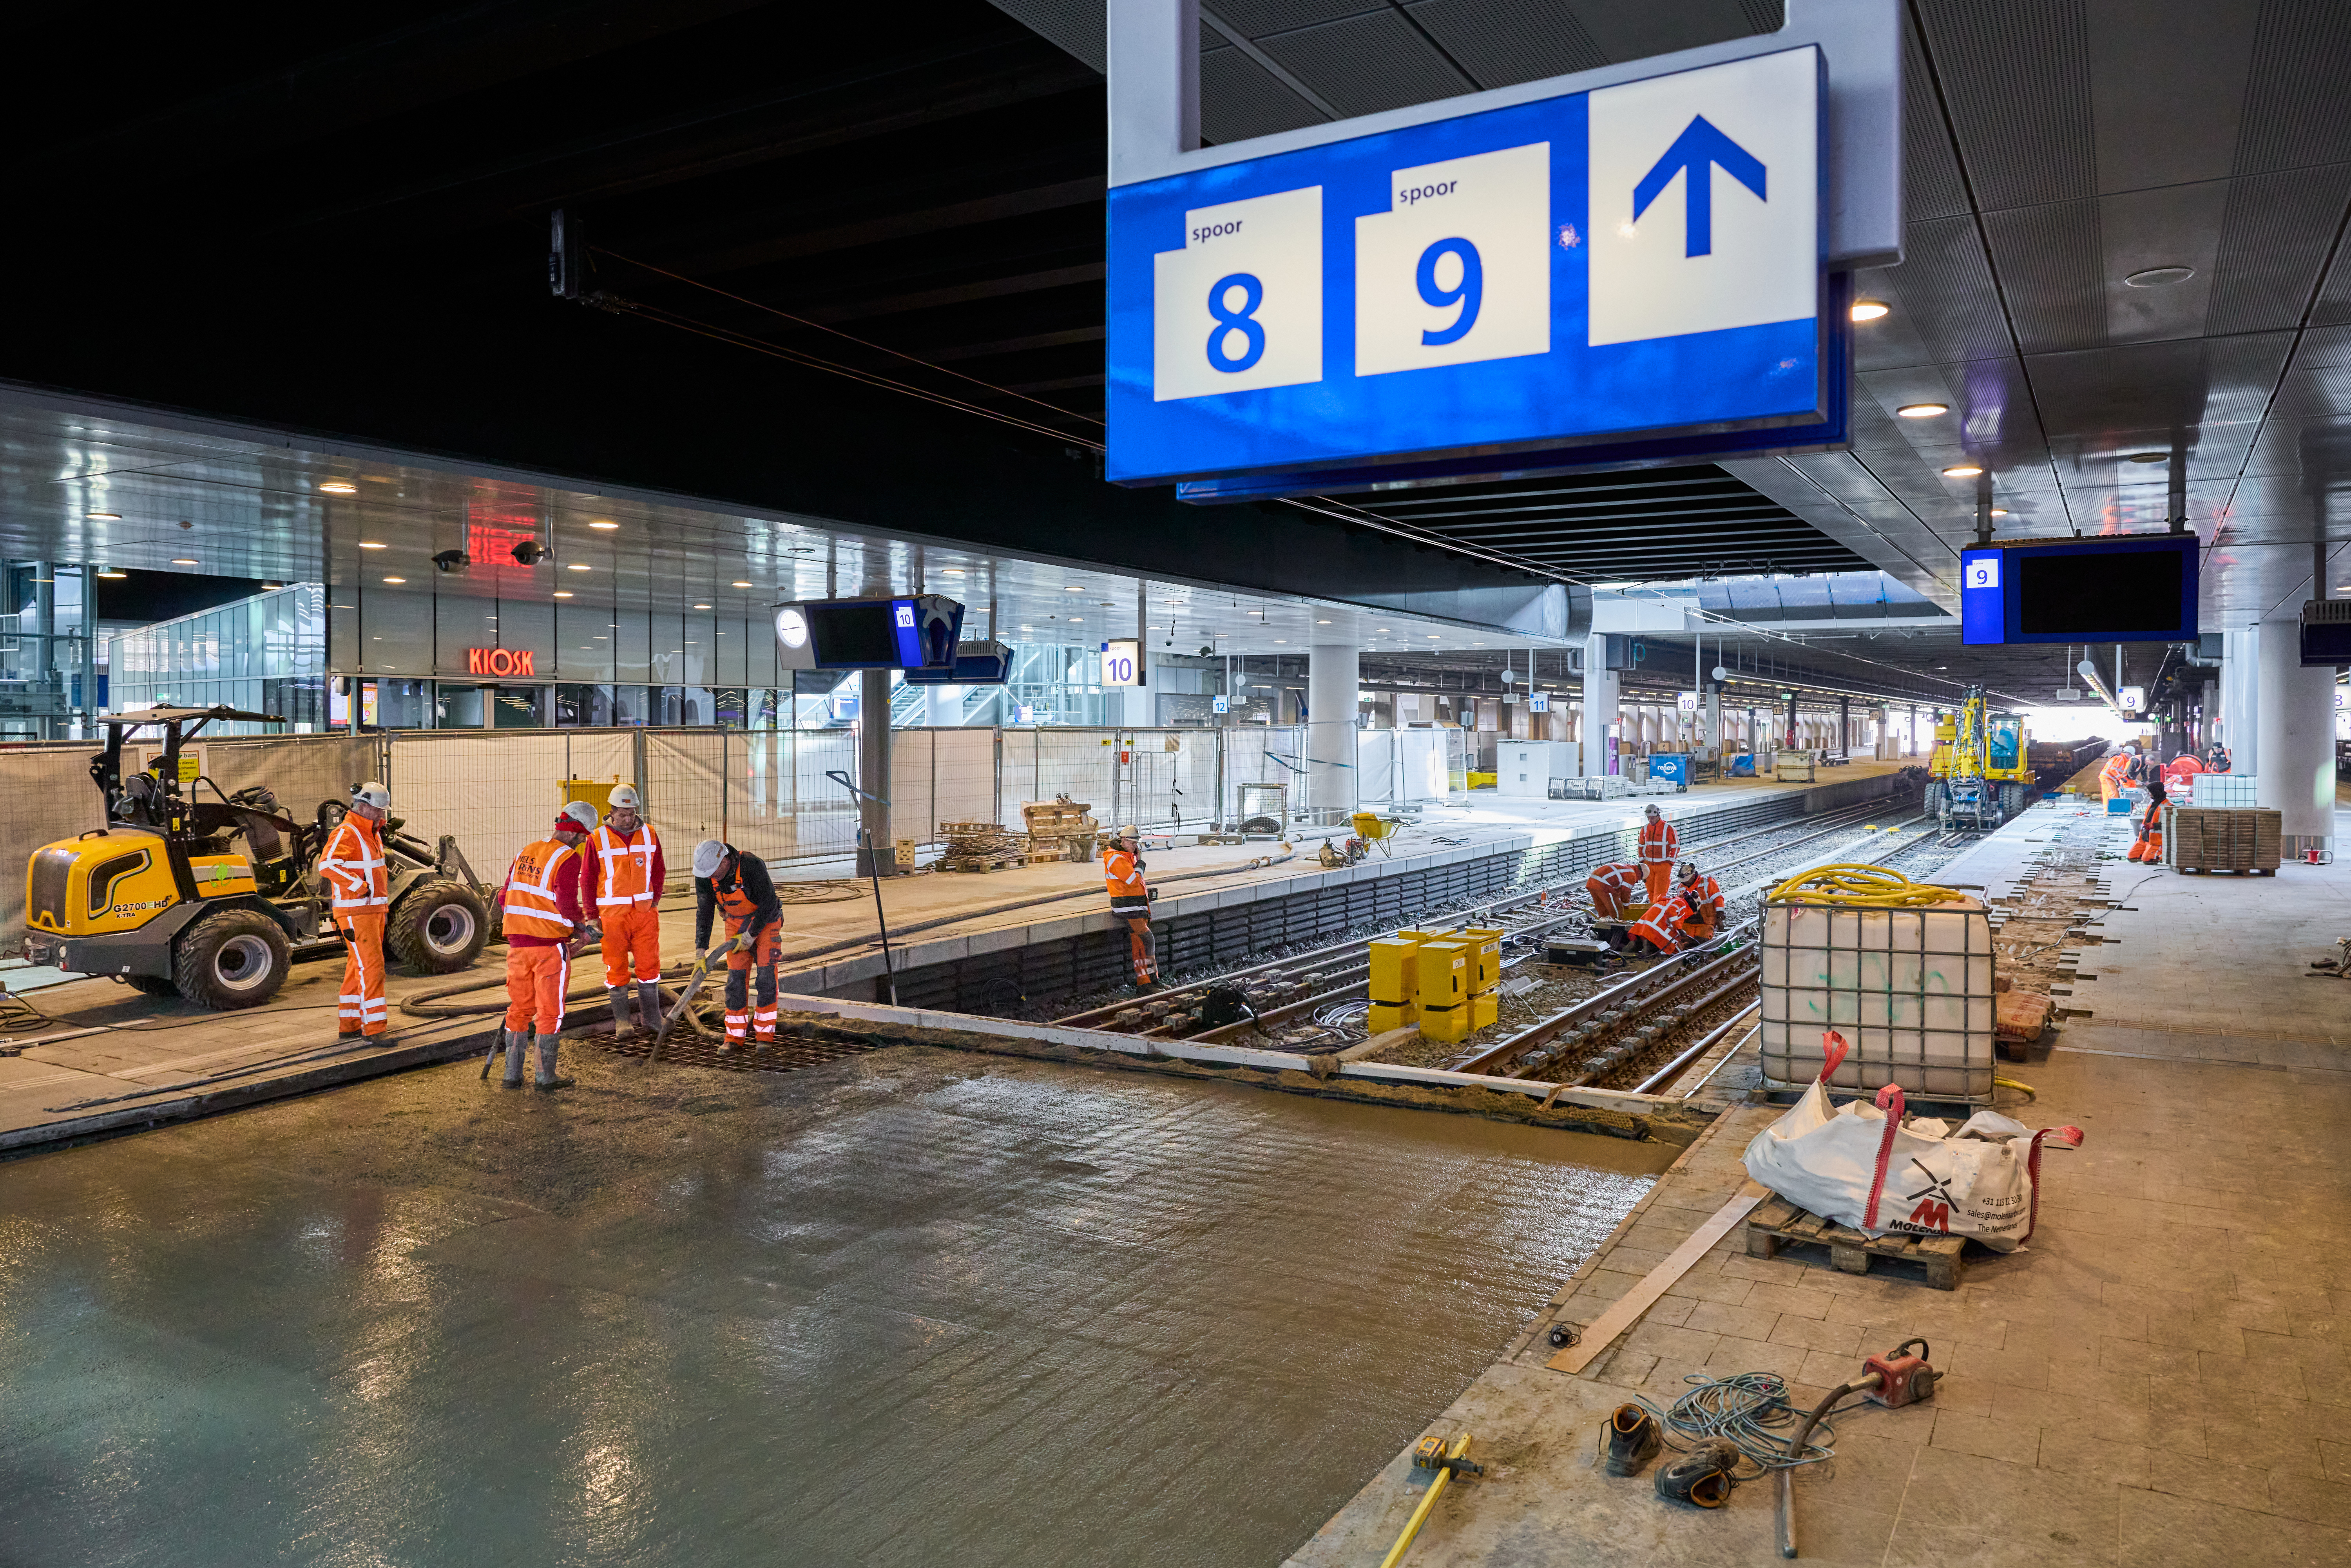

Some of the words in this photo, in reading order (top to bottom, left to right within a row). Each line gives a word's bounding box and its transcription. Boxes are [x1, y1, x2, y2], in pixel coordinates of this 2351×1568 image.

[1400, 180, 1457, 205] spoor
[1192, 219, 1243, 243] spoor
[1416, 237, 1483, 346] 9
[1206, 272, 1265, 373] 8
[1977, 570, 1987, 585] 9
[900, 614, 911, 625] 10
[470, 648, 534, 676] KIOSK
[1108, 658, 1132, 681] 10
[1534, 701, 1544, 710] 11
[1682, 700, 1694, 709] 10
[2127, 697, 2135, 707] 9
[2335, 695, 2342, 706] 8
[1215, 703, 1225, 711] 12
[113, 900, 168, 913] G2700EHD
[2011, 1196, 2017, 1204] 30
[1978, 1224, 1990, 1232] The
